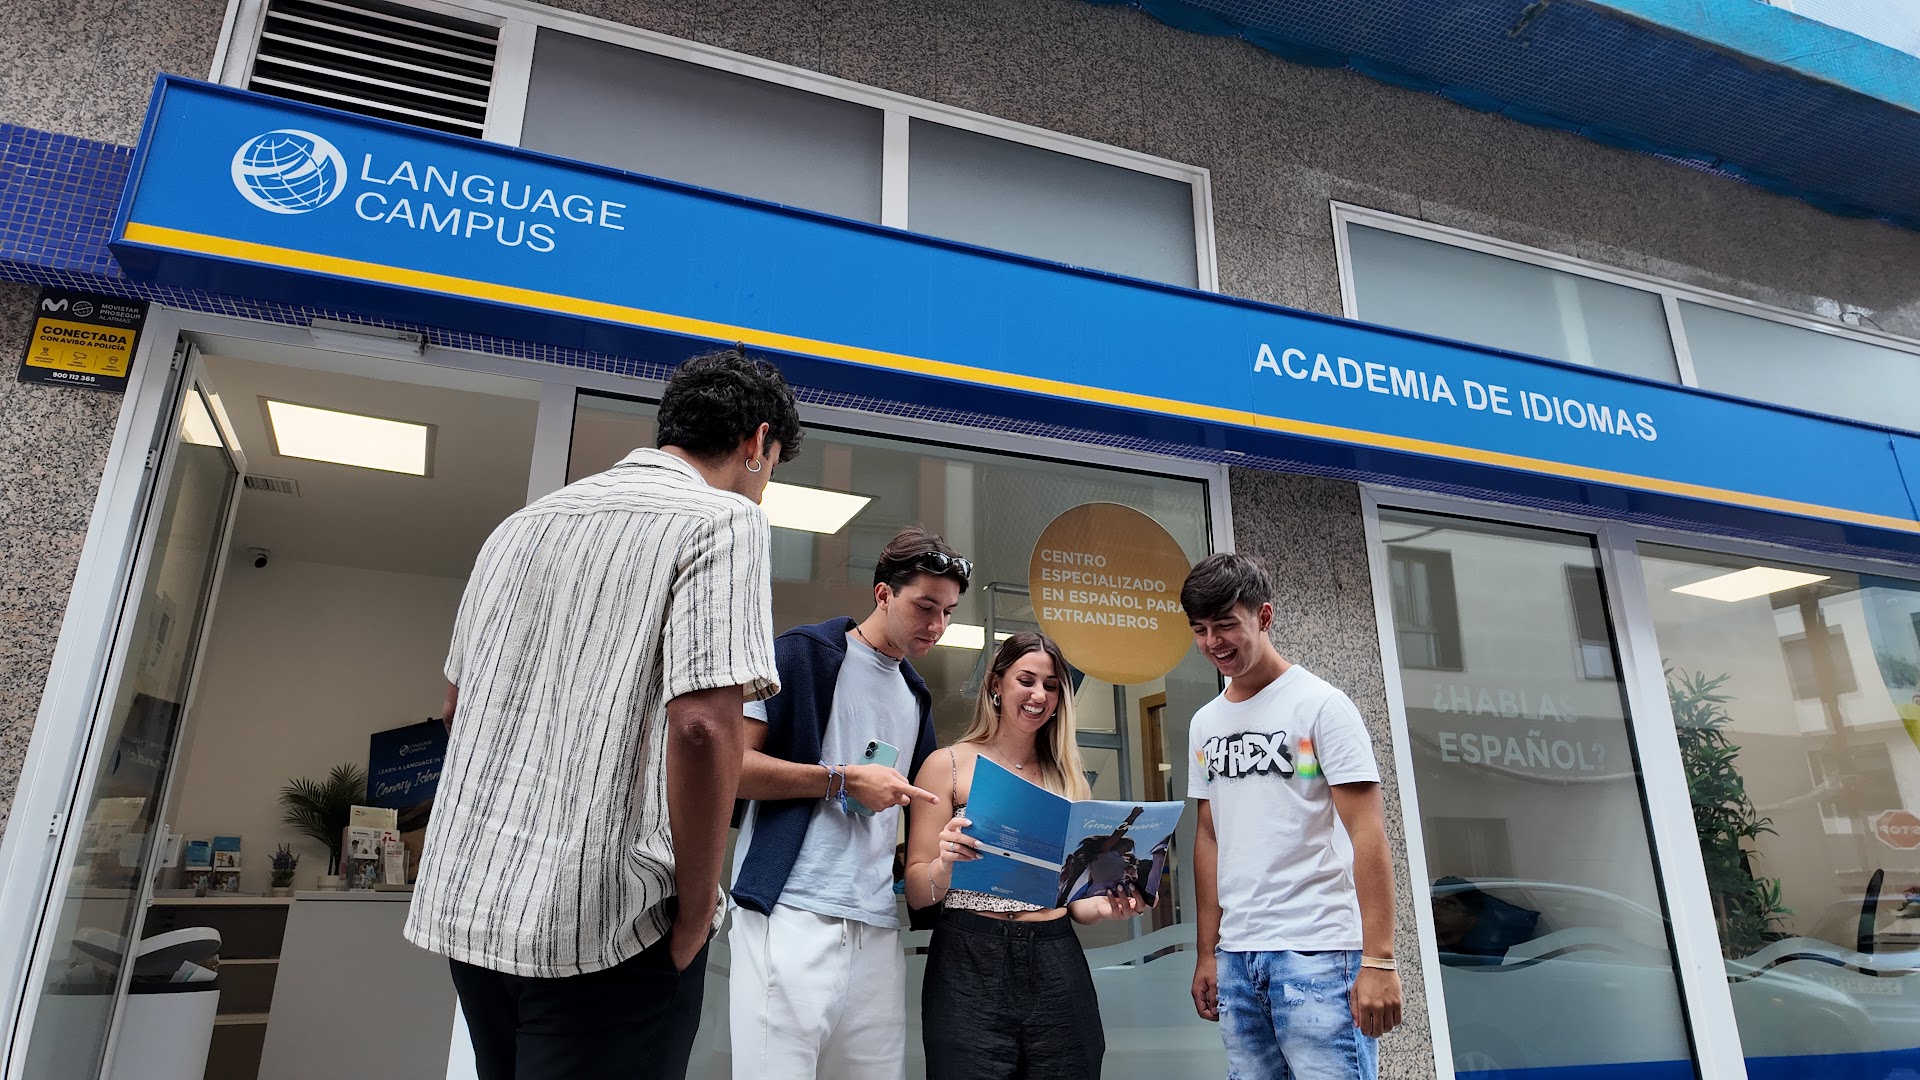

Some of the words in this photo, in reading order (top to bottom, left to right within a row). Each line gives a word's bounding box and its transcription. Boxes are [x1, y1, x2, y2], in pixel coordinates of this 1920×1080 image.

[361, 153, 627, 231] LANGUAGE
[355, 191, 556, 253] CAMPUS
[100, 309, 141, 319] PROSEGUR
[101, 304, 139, 313] MOVISTAR
[98, 315, 131, 324] ALARMAS
[40, 335, 59, 343] CON
[60, 338, 86, 346] AVISO
[94, 342, 125, 351] POLICÍA
[42, 325, 127, 344] CONECTADA
[52, 371, 68, 379] 900
[1253, 343, 1458, 406] ACADEMIA
[1463, 379, 1512, 416] DE
[1519, 390, 1658, 442] IDIOMAS
[1041, 549, 1107, 568] CENTRO
[1041, 568, 1166, 592] ESPECIALIZADO
[1042, 587, 1064, 601] EN
[1069, 590, 1143, 610] ESPAÑOL
[1042, 607, 1159, 630] EXTRANJEROS
[1432, 683, 1579, 723] ¿HABLAS
[1438, 728, 1608, 772] ESPAÑOL?
[378, 767, 397, 776] LEARN
[403, 759, 433, 770] LANGUAGE
